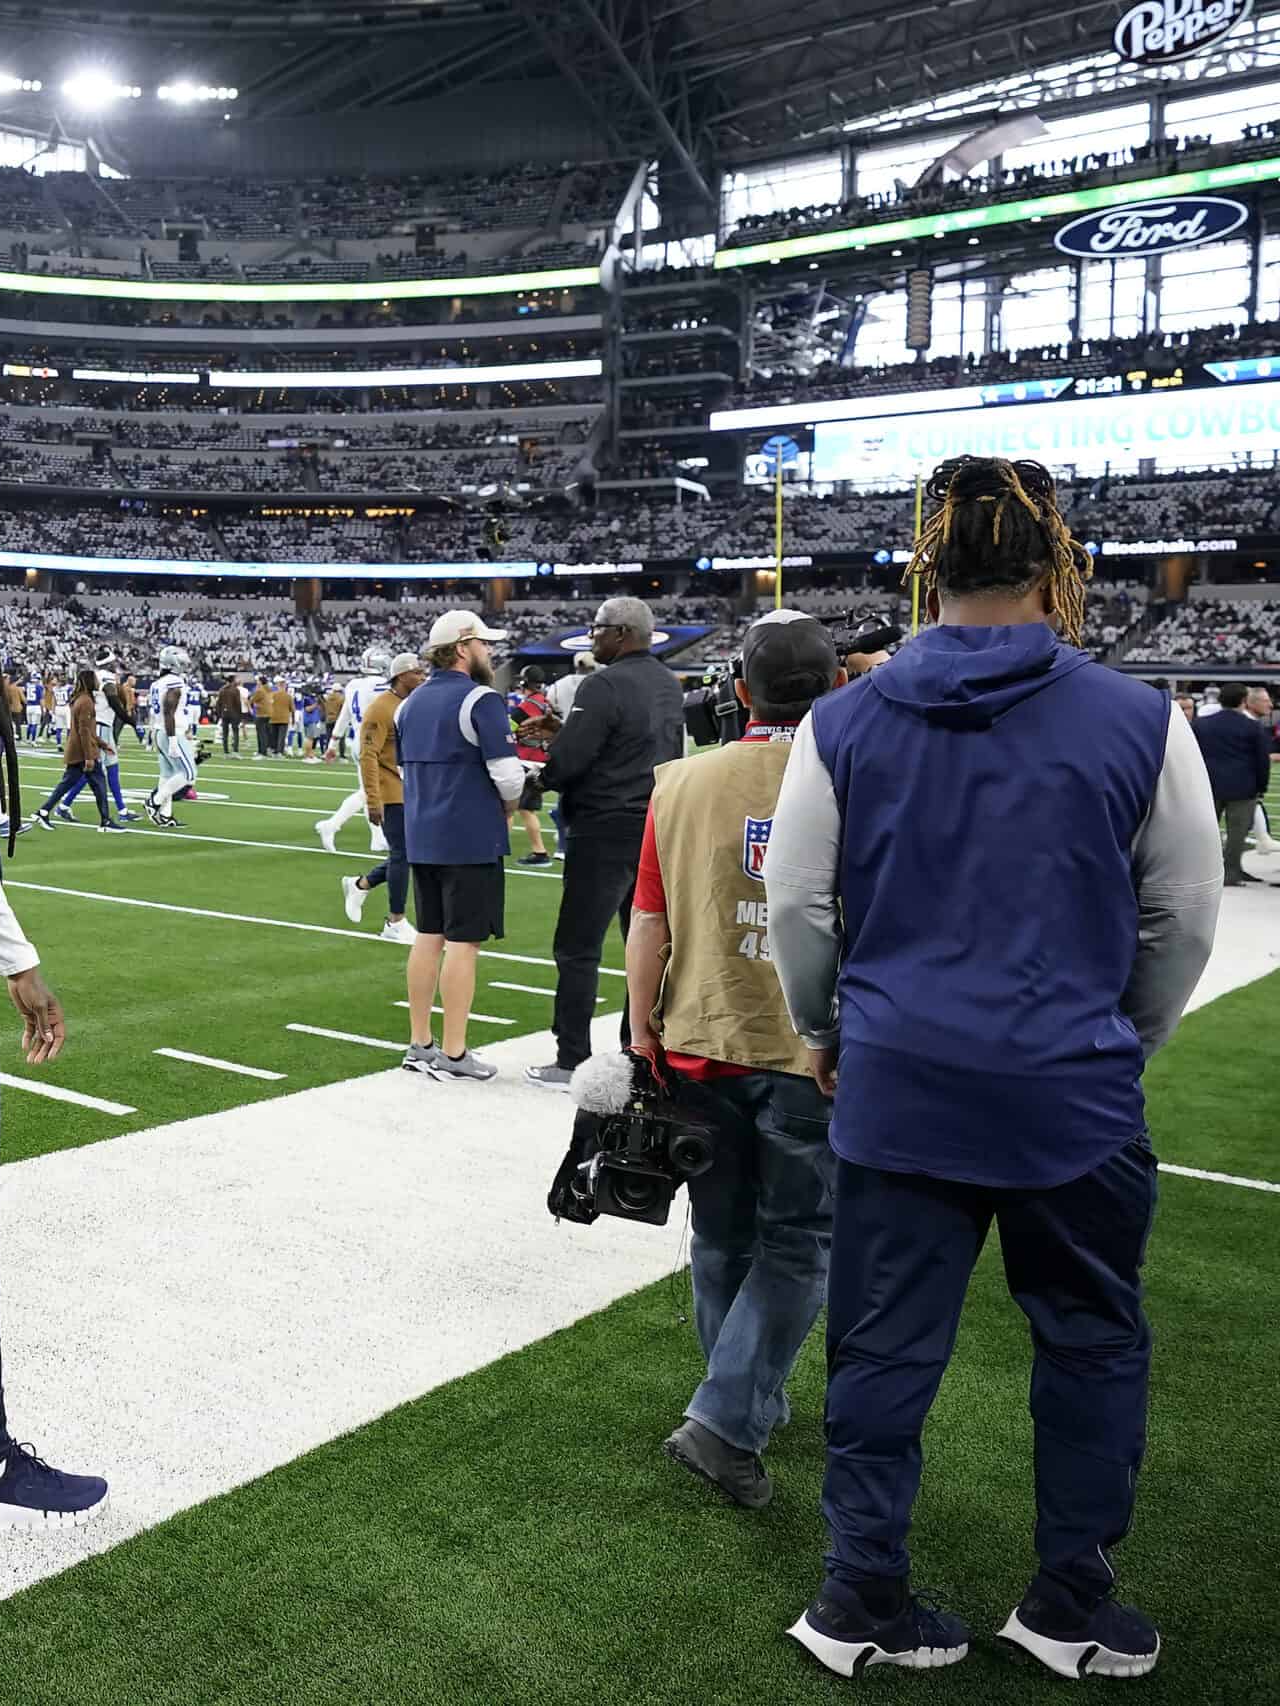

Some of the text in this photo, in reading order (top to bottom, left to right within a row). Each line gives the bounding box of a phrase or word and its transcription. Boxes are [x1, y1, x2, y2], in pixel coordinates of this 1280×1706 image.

[1114, 0, 1235, 58] Pepper
[1090, 206, 1208, 252] Ford
[1101, 538, 1238, 555] Blockchain.com
[351, 690, 362, 722] 4
